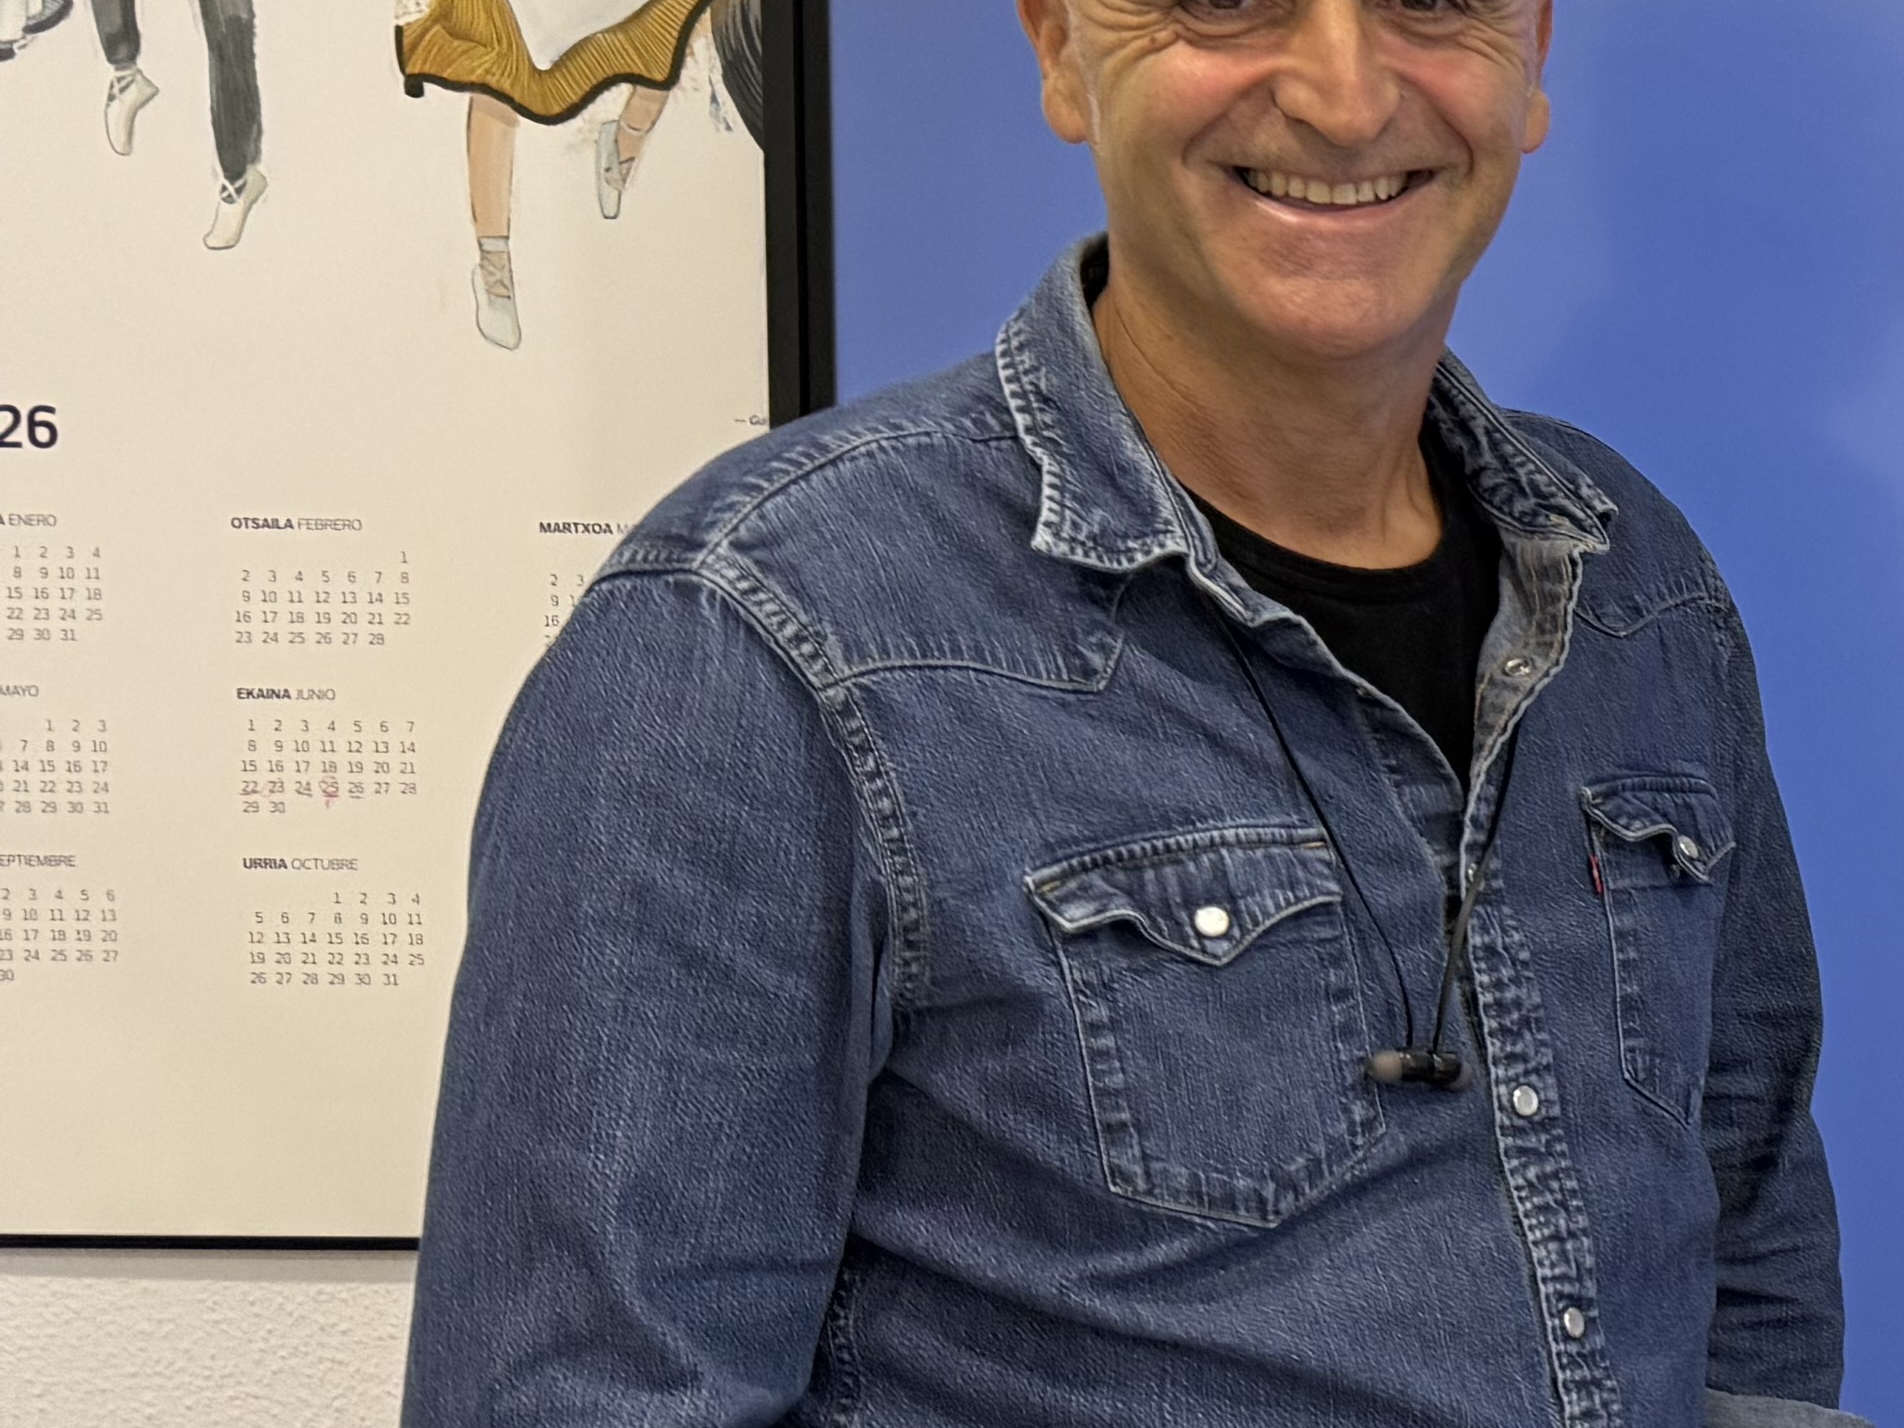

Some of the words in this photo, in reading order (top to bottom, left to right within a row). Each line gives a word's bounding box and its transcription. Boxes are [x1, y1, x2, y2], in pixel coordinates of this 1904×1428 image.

[230, 516, 295, 531] OTSAILA
[297, 517, 363, 532] FEBRERO
[539, 521, 614, 535] MARTXOA
[13, 545, 21, 559] 1
[39, 546, 48, 558] 2
[66, 546, 74, 559] 3
[92, 547, 101, 558] 4
[401, 551, 408, 564] 1
[13, 566, 22, 579] 8
[38, 567, 49, 579] 9
[58, 566, 75, 579] 10
[85, 567, 100, 580] 11
[242, 569, 250, 582] 2
[268, 570, 277, 583] 3
[295, 570, 303, 582] 4
[321, 570, 330, 583] 5
[347, 571, 356, 584] 6
[374, 571, 382, 584] 7
[400, 572, 409, 584] 8
[6, 586, 23, 600] 15
[33, 587, 49, 600] 16
[59, 587, 76, 601] 17
[85, 587, 102, 601] 18
[242, 590, 251, 602] 9
[261, 589, 277, 603] 10
[288, 590, 304, 603] 11
[314, 590, 330, 604] 12
[341, 591, 358, 604] 13
[367, 591, 383, 604] 14
[394, 592, 410, 605] 15
[6, 607, 24, 620] 22
[33, 607, 50, 620] 23
[59, 608, 77, 621] 24
[235, 610, 252, 623] 16
[261, 610, 278, 623] 17
[288, 611, 305, 624] 18
[315, 612, 331, 624] 19
[341, 612, 358, 625] 20
[368, 612, 384, 625] 21
[393, 612, 410, 625] 22
[60, 628, 77, 641] 31
[235, 631, 253, 644] 23
[262, 631, 279, 644] 24
[342, 632, 358, 645] 27
[368, 633, 385, 645] 28
[236, 687, 292, 701] EKAINA
[294, 688, 337, 701] JUNIO
[46, 719, 55, 732] 1
[72, 719, 80, 732] 2
[98, 719, 107, 733] 3
[248, 719, 256, 731] 1
[274, 719, 282, 732] 2
[301, 719, 309, 732] 3
[327, 720, 336, 732] 4
[353, 720, 362, 733] 5
[380, 720, 389, 733] 6
[407, 721, 414, 732] 7
[20, 739, 28, 752] 7
[46, 739, 55, 752] 8
[72, 740, 81, 753] 9
[91, 740, 107, 753] 10
[248, 739, 257, 752] 8
[274, 740, 283, 752] 9
[293, 739, 310, 753] 10
[319, 740, 336, 753] 11
[347, 740, 363, 753] 12
[372, 741, 389, 753] 13
[400, 741, 416, 754] 14
[12, 759, 29, 773] 14
[39, 759, 56, 773] 15
[65, 760, 82, 774] 16
[92, 760, 108, 773] 17
[241, 760, 258, 772] 15
[267, 760, 284, 773] 16
[294, 760, 310, 774] 17
[321, 761, 337, 774] 18
[347, 761, 364, 774] 19
[373, 761, 390, 774] 20
[400, 762, 416, 774] 21
[13, 780, 30, 793] 21
[40, 780, 56, 794] 22
[66, 780, 83, 794] 23
[92, 781, 109, 794] 24
[374, 782, 390, 795] 27
[401, 782, 417, 795] 28
[67, 801, 84, 814] 30
[93, 801, 110, 814] 31
[242, 800, 259, 813] 29
[269, 801, 286, 814] 30
[242, 857, 289, 871] URRIA
[290, 858, 359, 872] OCTUBRE
[1, 888, 11, 900] 2
[28, 888, 38, 901] 3
[55, 889, 64, 900] 4
[80, 889, 89, 901] 5
[106, 889, 115, 902] 6
[333, 892, 341, 904] 1
[359, 892, 368, 905] 2
[387, 892, 396, 905] 3
[411, 893, 420, 905] 4
[2, 908, 12, 921] 9
[22, 908, 38, 921] 10
[49, 909, 65, 921] 11
[74, 909, 91, 922] 12
[101, 909, 117, 922] 13
[255, 911, 264, 924] 5
[281, 912, 290, 924] 6
[308, 912, 316, 924] 7
[334, 912, 342, 925] 8
[360, 913, 369, 925] 9
[381, 912, 397, 925] 10
[407, 913, 422, 925] 11
[23, 929, 39, 941] 17
[50, 929, 66, 941] 18
[100, 930, 118, 942] 20
[248, 931, 264, 944] 12
[274, 931, 290, 944] 13
[301, 932, 317, 944] 14
[327, 932, 343, 945] 15
[353, 932, 369, 945] 16
[382, 933, 398, 946] 17
[408, 933, 423, 946] 18
[24, 949, 40, 962] 24
[51, 949, 67, 962] 25
[102, 949, 118, 962] 27
[249, 951, 266, 964] 19
[301, 952, 317, 965] 21
[328, 952, 344, 965] 22
[354, 953, 371, 965] 23
[381, 953, 399, 966] 24
[408, 953, 424, 966] 25
[275, 972, 292, 985] 27
[355, 973, 371, 986] 30
[383, 973, 399, 986] 31
